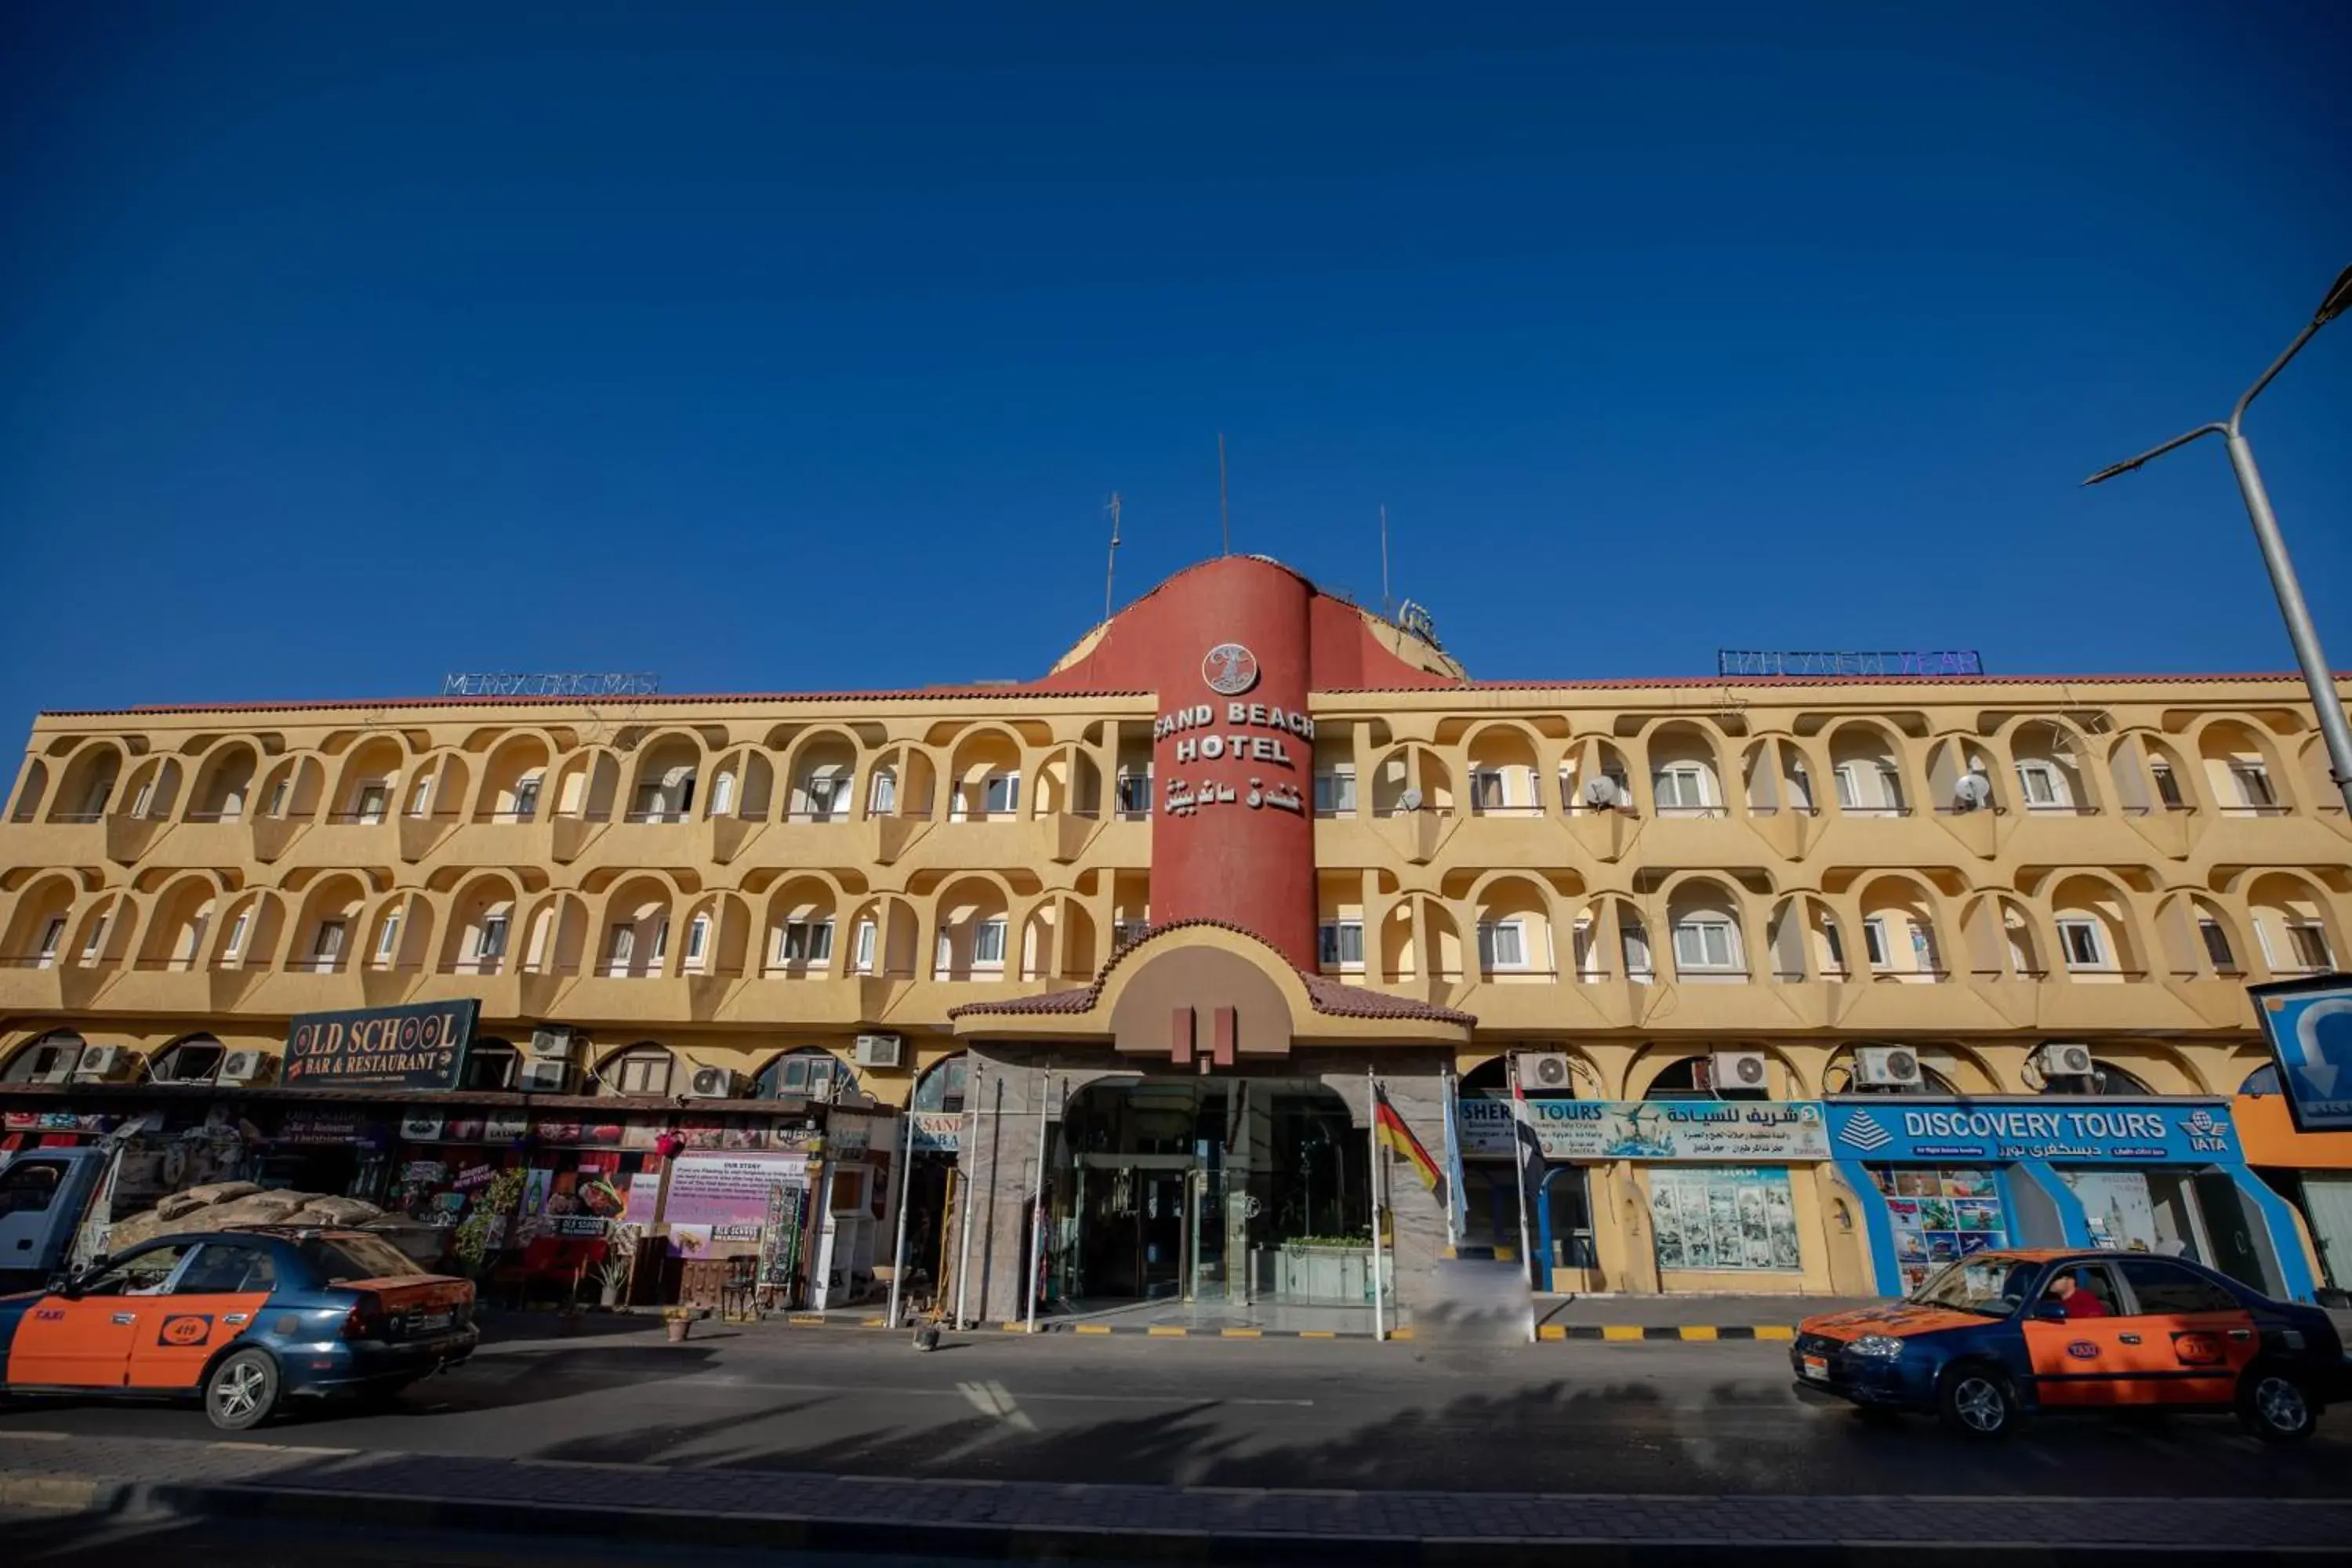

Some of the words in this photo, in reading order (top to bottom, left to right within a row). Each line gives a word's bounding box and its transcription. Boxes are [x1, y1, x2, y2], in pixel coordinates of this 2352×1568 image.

[1153, 704, 1213, 740] SAND
[1228, 702, 1316, 741] BEACH
[1177, 735, 1290, 763] HOTEL
[1245, 777, 1301, 811] فندق
[294, 1022, 343, 1056] OLD
[347, 1014, 458, 1054] SCHOOL
[305, 1058, 330, 1075] BAR
[333, 1058, 343, 1073] &
[347, 1051, 438, 1073] RESTAURANT
[1464, 1104, 1512, 1119] SHER
[1537, 1104, 1602, 1120] TOURS
[1667, 1106, 1740, 1127] للسياحة
[1747, 1105, 1798, 1127] شريف
[1904, 1112, 2060, 1138] DISCOVERY
[2067, 1113, 2167, 1138] TOURS
[2192, 1138, 2229, 1152] IATA
[35, 1309, 66, 1321] TAXI
[2071, 1343, 2097, 1356] TAXI
